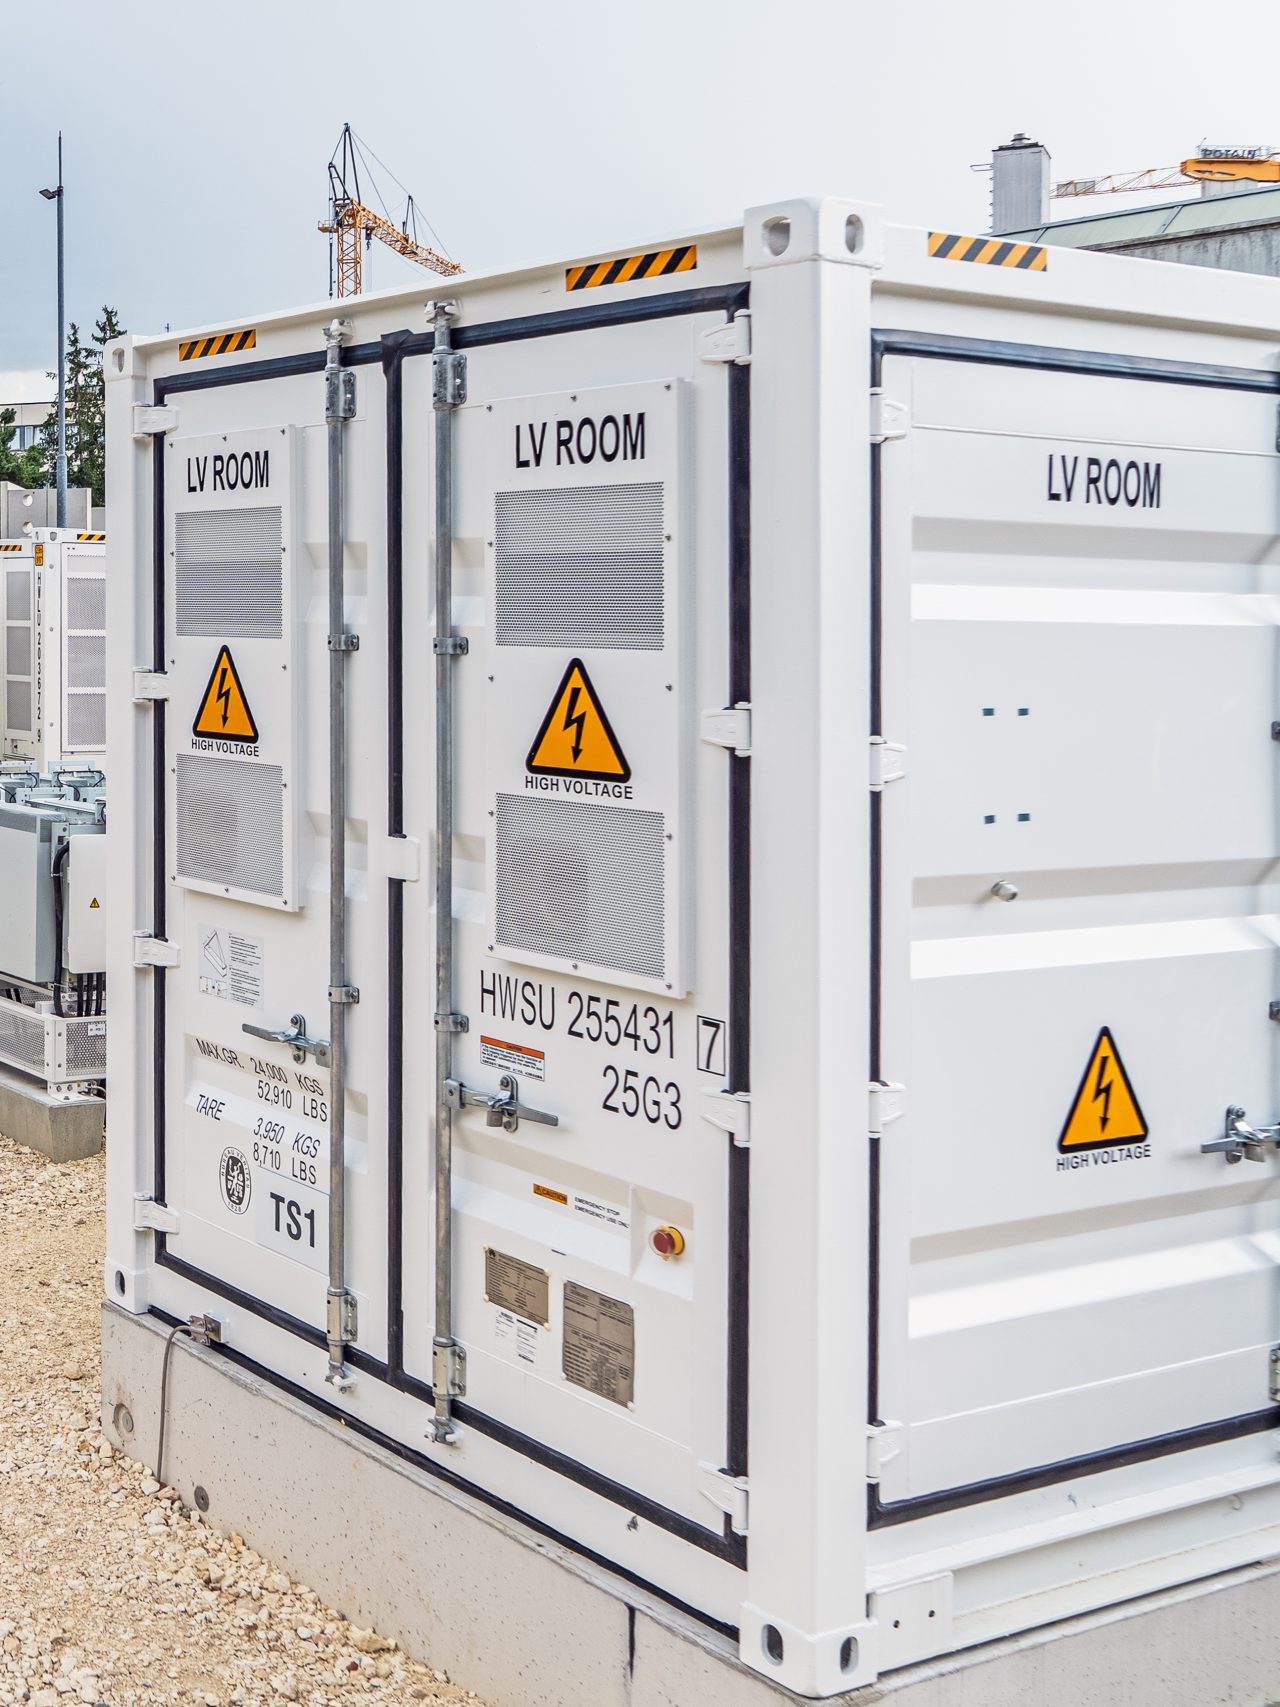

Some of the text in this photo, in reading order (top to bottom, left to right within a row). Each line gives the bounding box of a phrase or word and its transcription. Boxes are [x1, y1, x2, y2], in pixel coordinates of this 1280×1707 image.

[515, 411, 646, 469] LV ROOM
[187, 449, 270, 494] LV ROOM
[1047, 454, 1162, 509] LV ROOM
[191, 738, 260, 757] HIGH VOLTAGE
[525, 775, 634, 800] HIGH VOLTAGE
[480, 969, 721, 1070] HWSU 255431 7
[195, 1038, 324, 1097] MAX.GR. 24,000 KGS
[257, 1080, 328, 1123] 52,910 LBS
[601, 1064, 682, 1131] 25G3
[196, 1094, 321, 1159] TARE 3,950 KGS
[253, 1142, 317, 1185] 8,710 LBS
[1055, 1144, 1151, 1172] HIGH VOLTAGE
[269, 1191, 315, 1248] TS1
